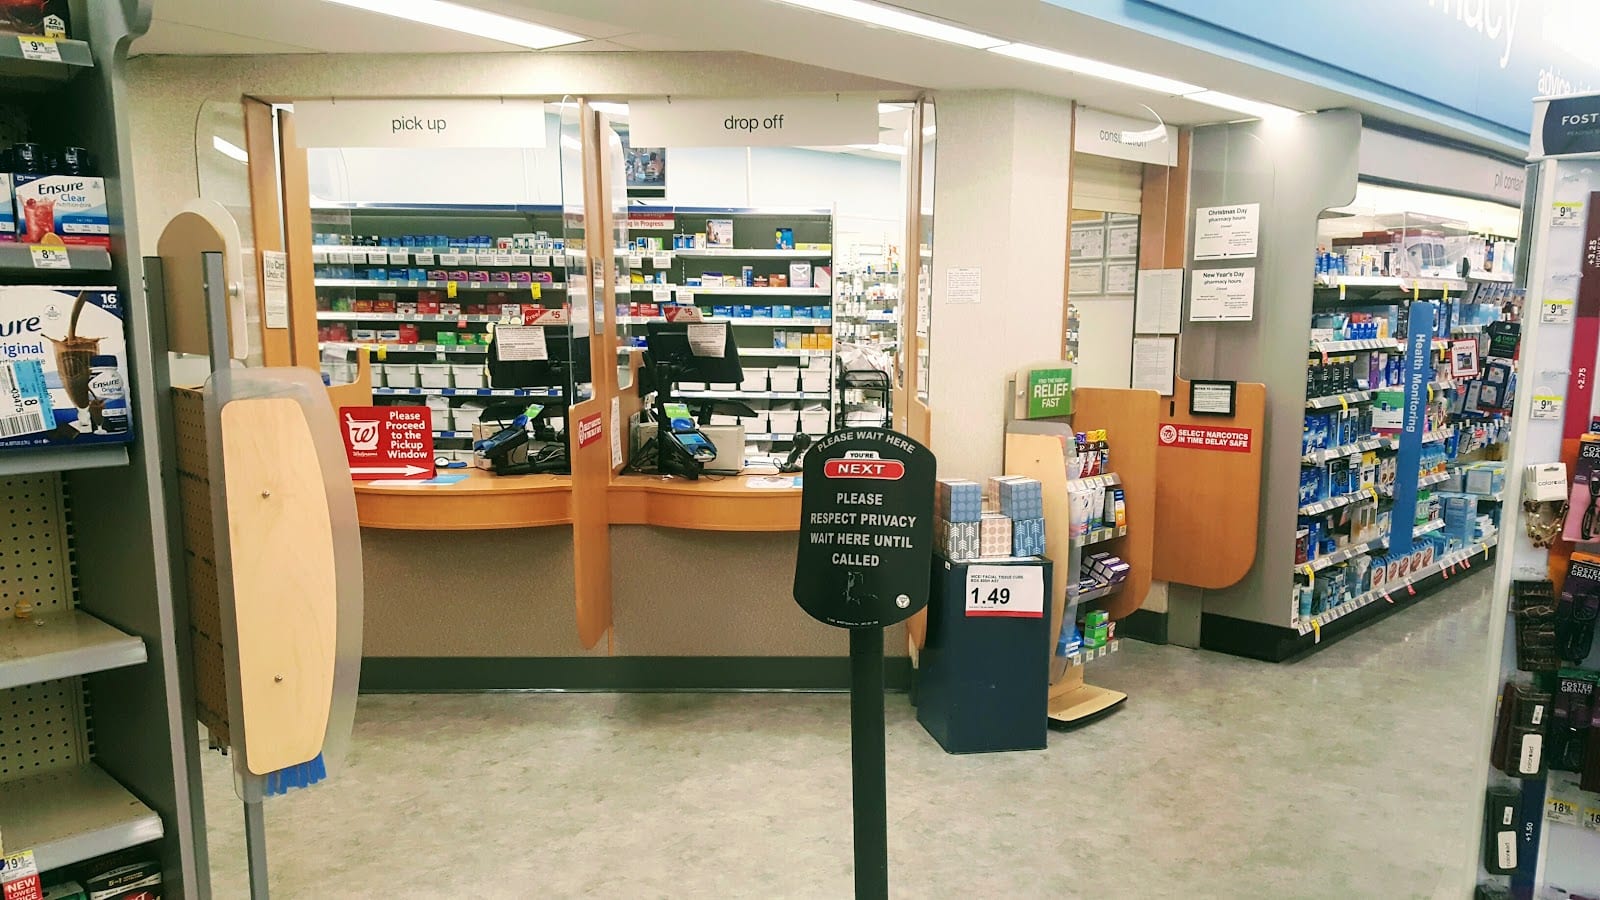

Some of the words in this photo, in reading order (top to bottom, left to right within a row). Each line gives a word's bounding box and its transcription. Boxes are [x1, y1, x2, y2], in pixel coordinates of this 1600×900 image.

[391, 116, 423, 133] pick
[427, 118, 447, 133] up
[724, 115, 761, 132] drop
[763, 114, 784, 130] off
[38, 182, 84, 195] Ensure
[60, 193, 86, 202] Clear
[101, 293, 117, 304] 16
[1413, 333, 1426, 370] Health
[1577, 368, 1586, 390] +2.75
[1033, 383, 1069, 398] RELIEF
[1041, 397, 1060, 408] FAST
[1405, 373, 1423, 433] Monitoring
[390, 411, 421, 421] Please
[386, 421, 426, 430] Proceed
[391, 431, 403, 440] to
[405, 430, 422, 440] the
[1178, 429, 1205, 437] SELECT
[1206, 431, 1249, 440] NARCOTICS
[391, 440, 424, 451] Pickup
[817, 431, 854, 453] PLEASE
[856, 431, 884, 440] WAIT
[885, 434, 916, 454] HERE
[1186, 437, 1204, 445] TIME
[1204, 438, 1228, 446] DELAY
[1229, 440, 1248, 448] SAFE
[387, 450, 428, 459] Window
[837, 463, 886, 474] NEXT
[836, 492, 884, 506] PLEASE
[810, 512, 857, 525] RESPECT
[860, 514, 917, 528] PRIVACY
[810, 532, 835, 545] WAIT
[837, 533, 870, 546] HERE
[874, 534, 913, 549] UNTIL
[831, 553, 880, 567] CALLED
[971, 587, 1010, 604] 1.49
[1561, 681, 1593, 690] FOSTER
[7, 877, 36, 893] NEW
[9, 887, 36, 900] LOWER
